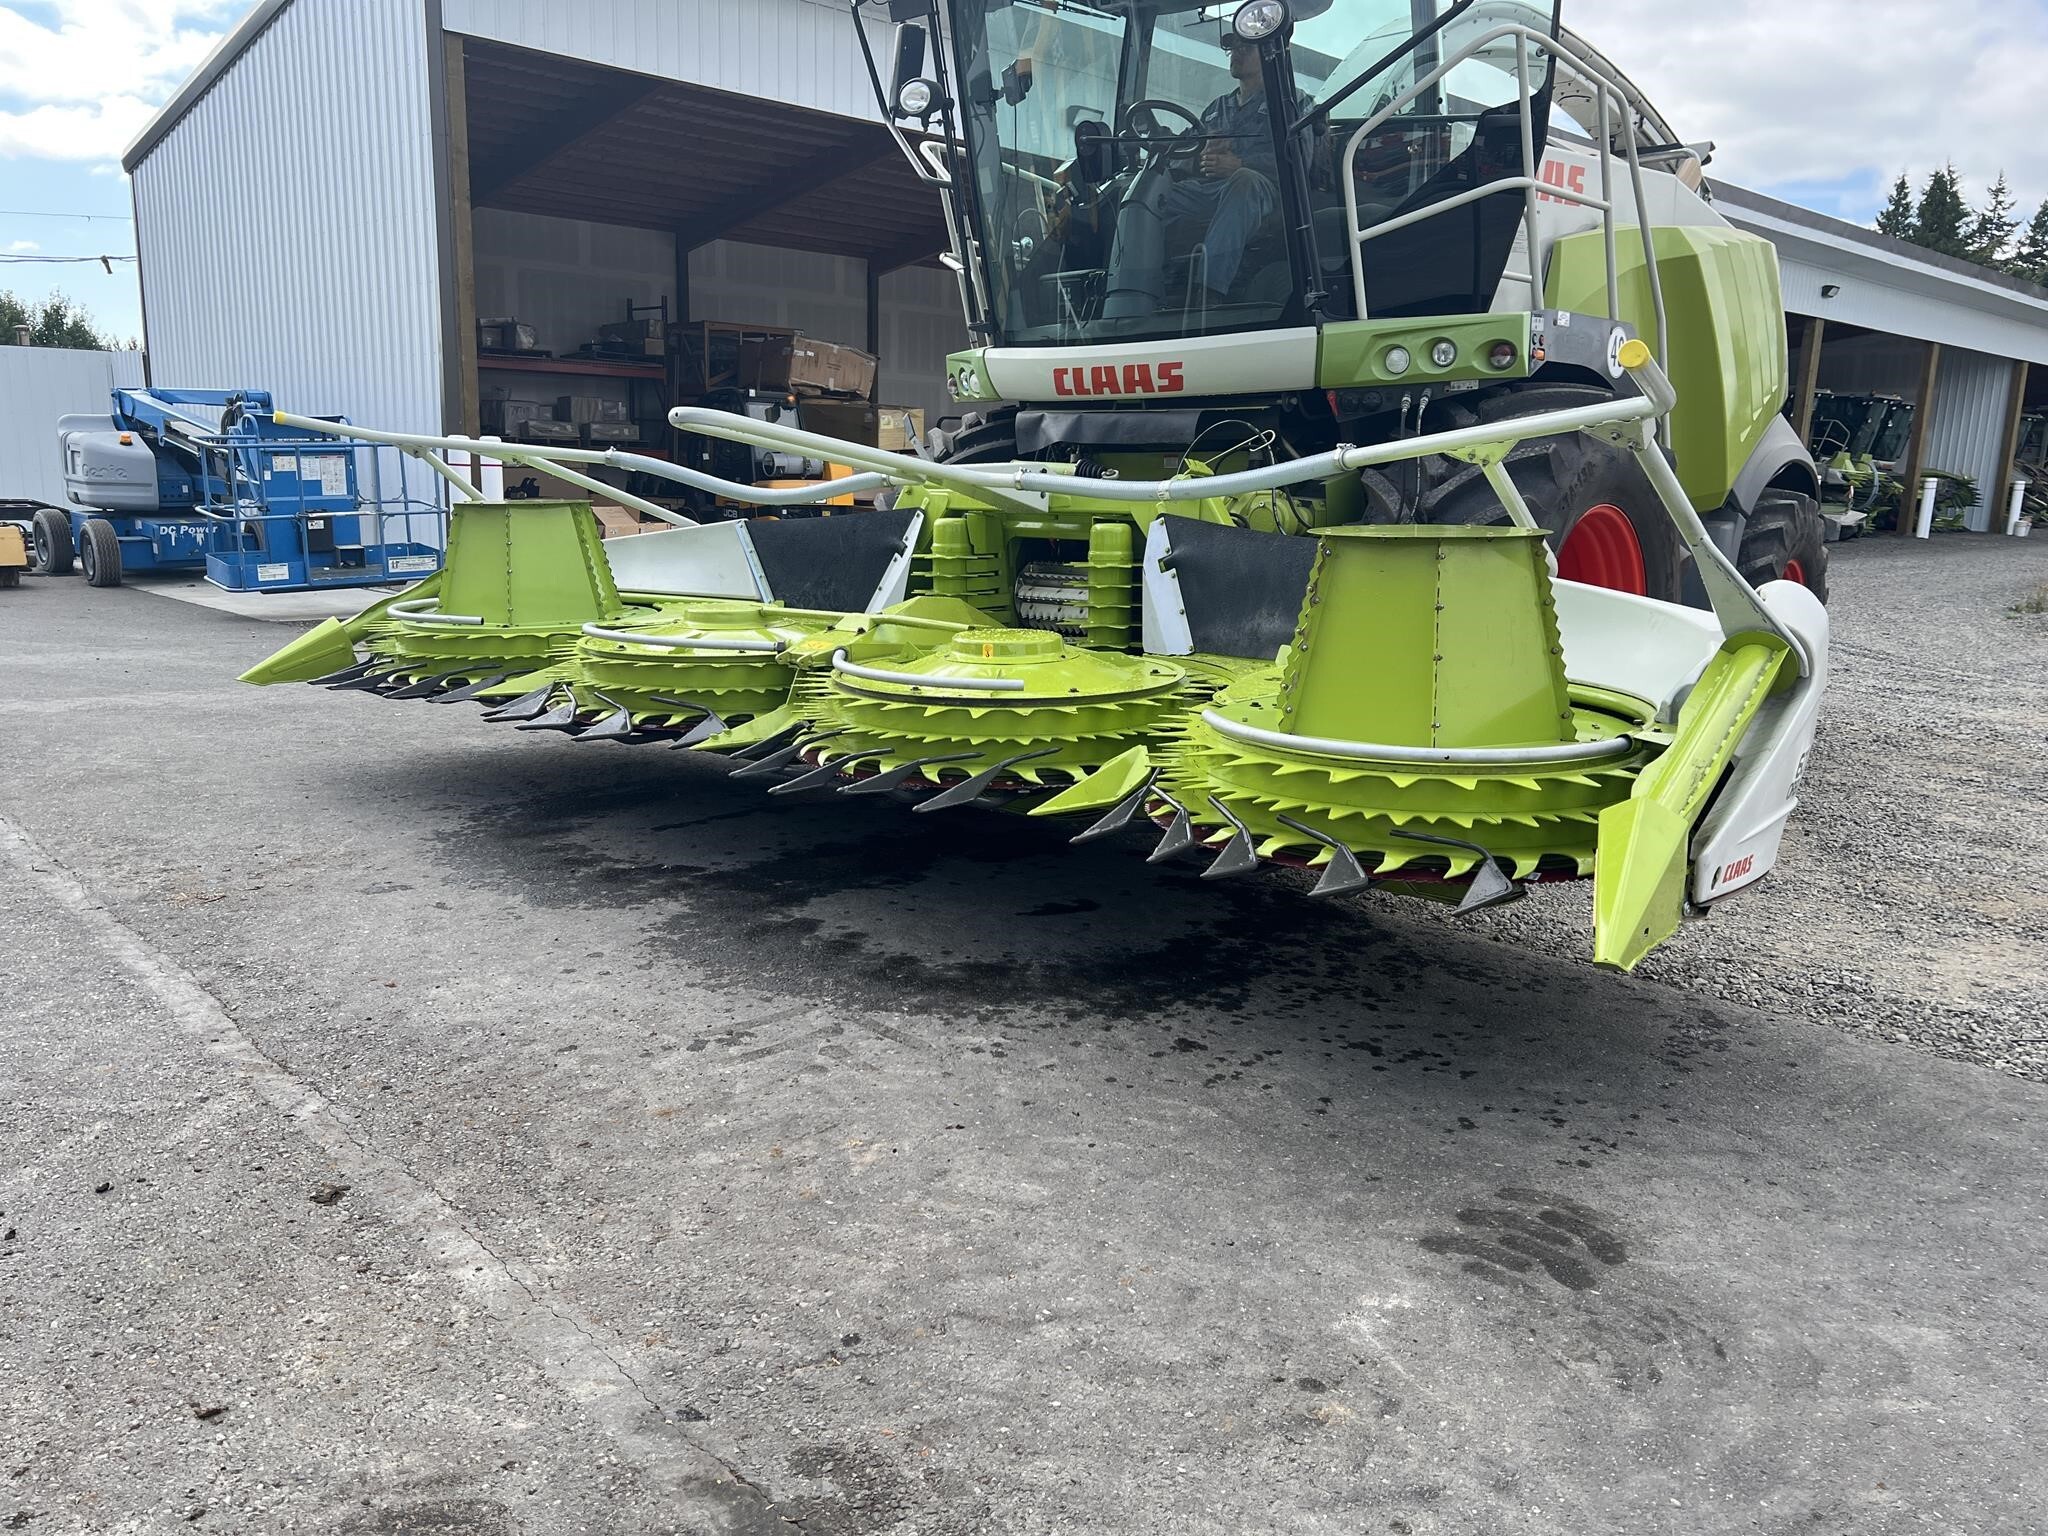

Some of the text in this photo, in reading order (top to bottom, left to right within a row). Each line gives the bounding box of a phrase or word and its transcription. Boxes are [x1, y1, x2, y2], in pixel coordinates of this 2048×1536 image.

[1053, 362, 1184, 396] CLAAS
[723, 508, 738, 518] JCB
[160, 525, 177, 535] DC
[1722, 854, 1754, 883] CLAAS
